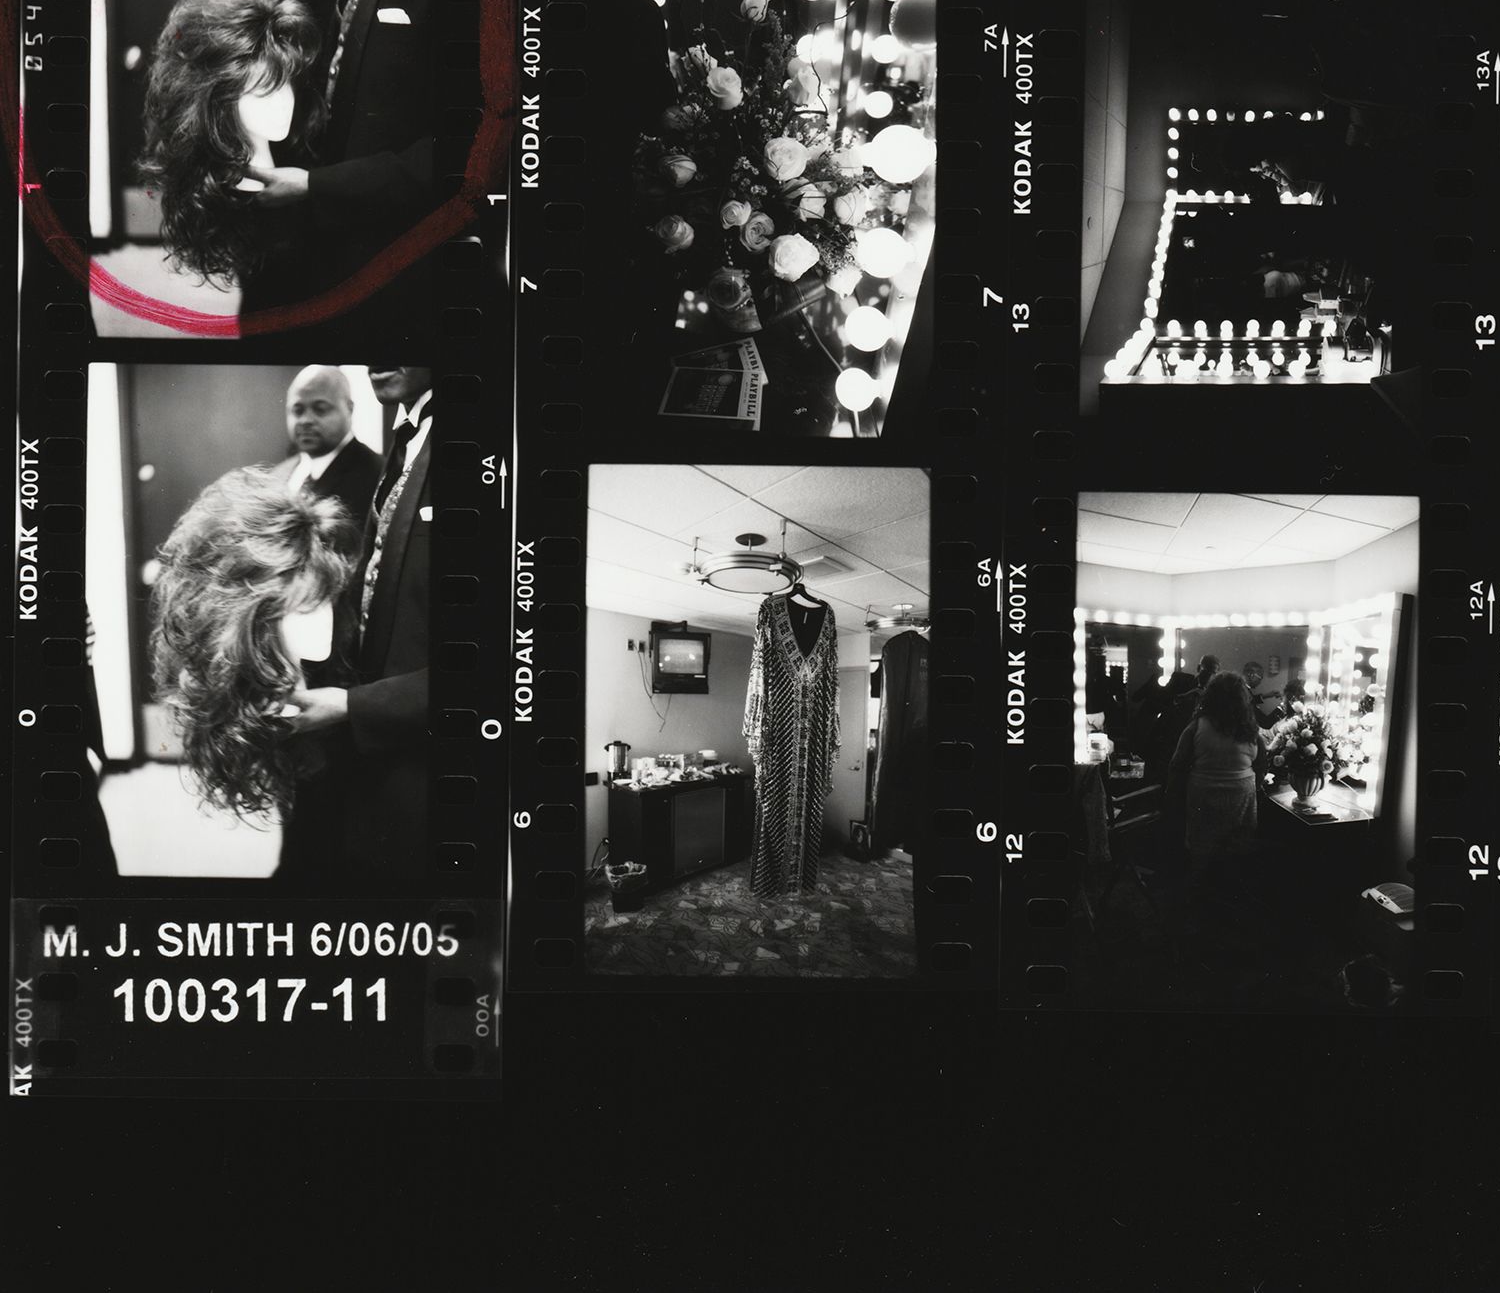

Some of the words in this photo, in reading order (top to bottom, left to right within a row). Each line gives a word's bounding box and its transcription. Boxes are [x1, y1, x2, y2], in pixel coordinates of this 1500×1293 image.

[984, 24, 997, 51] 7A
[1477, 51, 1490, 90] 13A
[25, 183, 42, 194] 1
[487, 195, 506, 205] 1
[984, 288, 1003, 306] 7
[1012, 304, 1029, 332] 13
[1475, 315, 1495, 350] 13
[747, 373, 759, 417] PLAYBILL
[20, 440, 38, 509] 400TX
[20, 527, 37, 619] KODAK
[517, 542, 534, 611] 400TX
[1009, 564, 1026, 633] 400TX
[515, 629, 533, 721] KODAK
[1007, 651, 1025, 744] KODAK
[19, 709, 36, 726] 0
[514, 812, 530, 828] 6
[977, 822, 997, 842] 6
[1006, 834, 1022, 863] 12
[43, 924, 89, 958] M.
[105, 923, 140, 958] J.
[157, 922, 294, 958] SMITH
[310, 922, 460, 958] 6/06/05
[15, 978, 33, 1047] 400TX
[113, 977, 388, 1023] 100317-11
